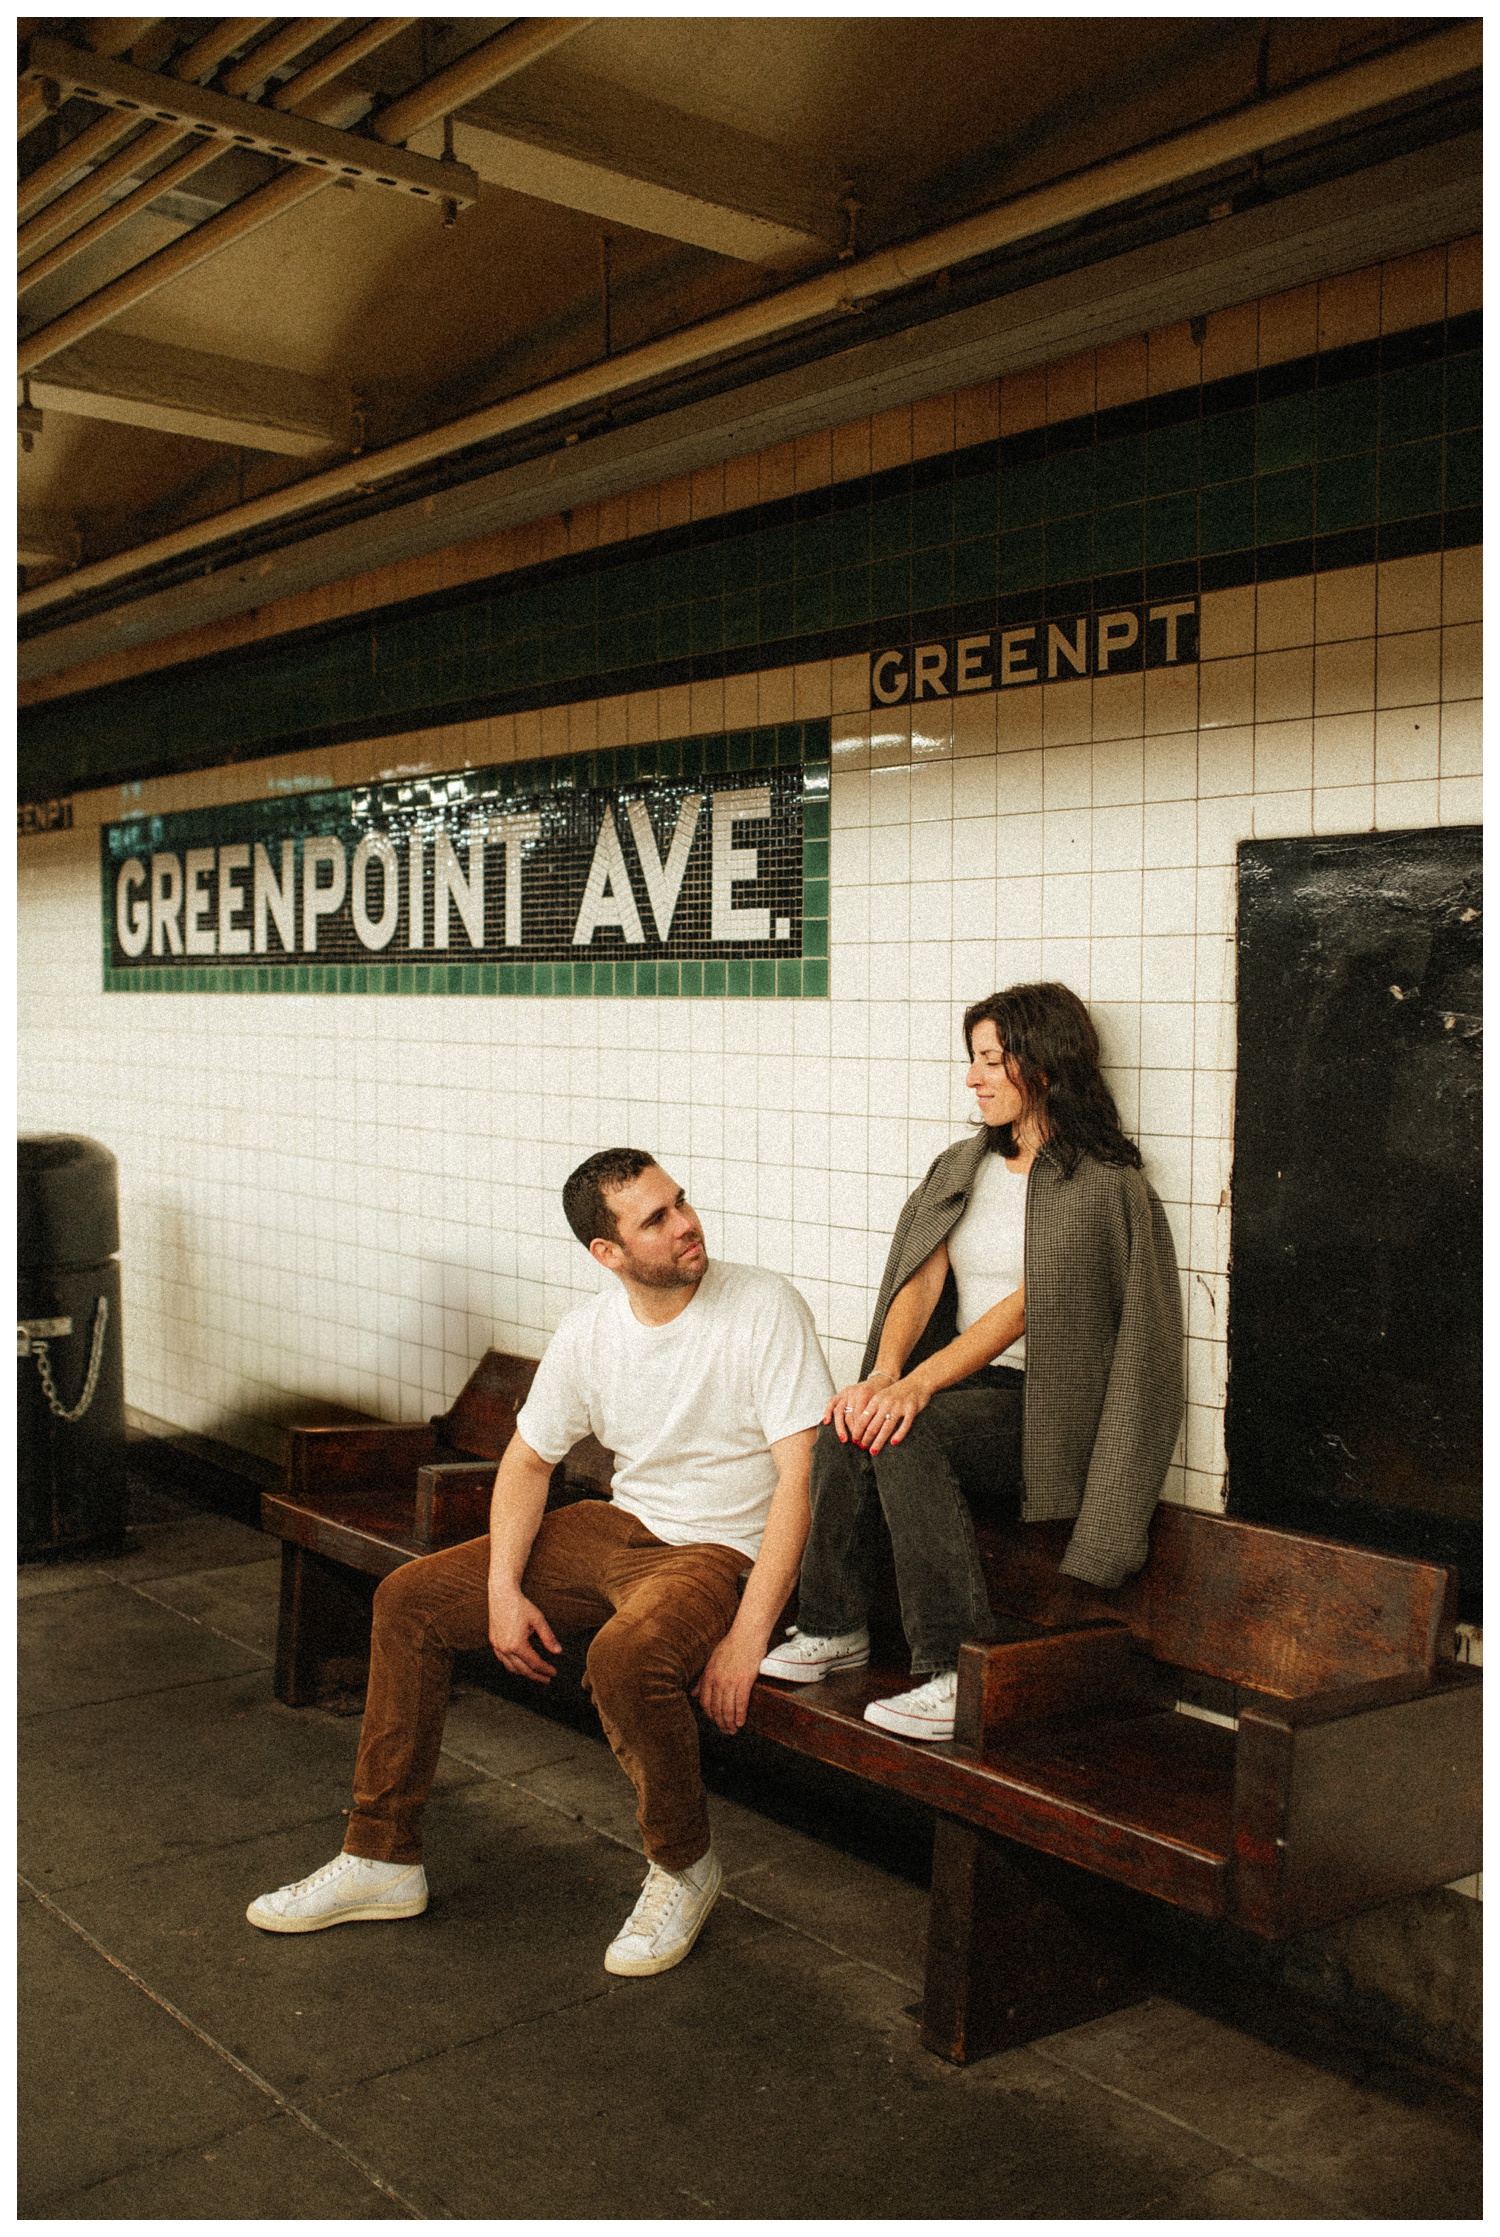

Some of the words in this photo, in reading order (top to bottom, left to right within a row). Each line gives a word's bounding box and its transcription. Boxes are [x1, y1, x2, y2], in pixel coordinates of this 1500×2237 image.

[872, 601, 1195, 703] GREENPT
[116, 812, 541, 957] GREENPOINT
[572, 787, 791, 943] AVE.
